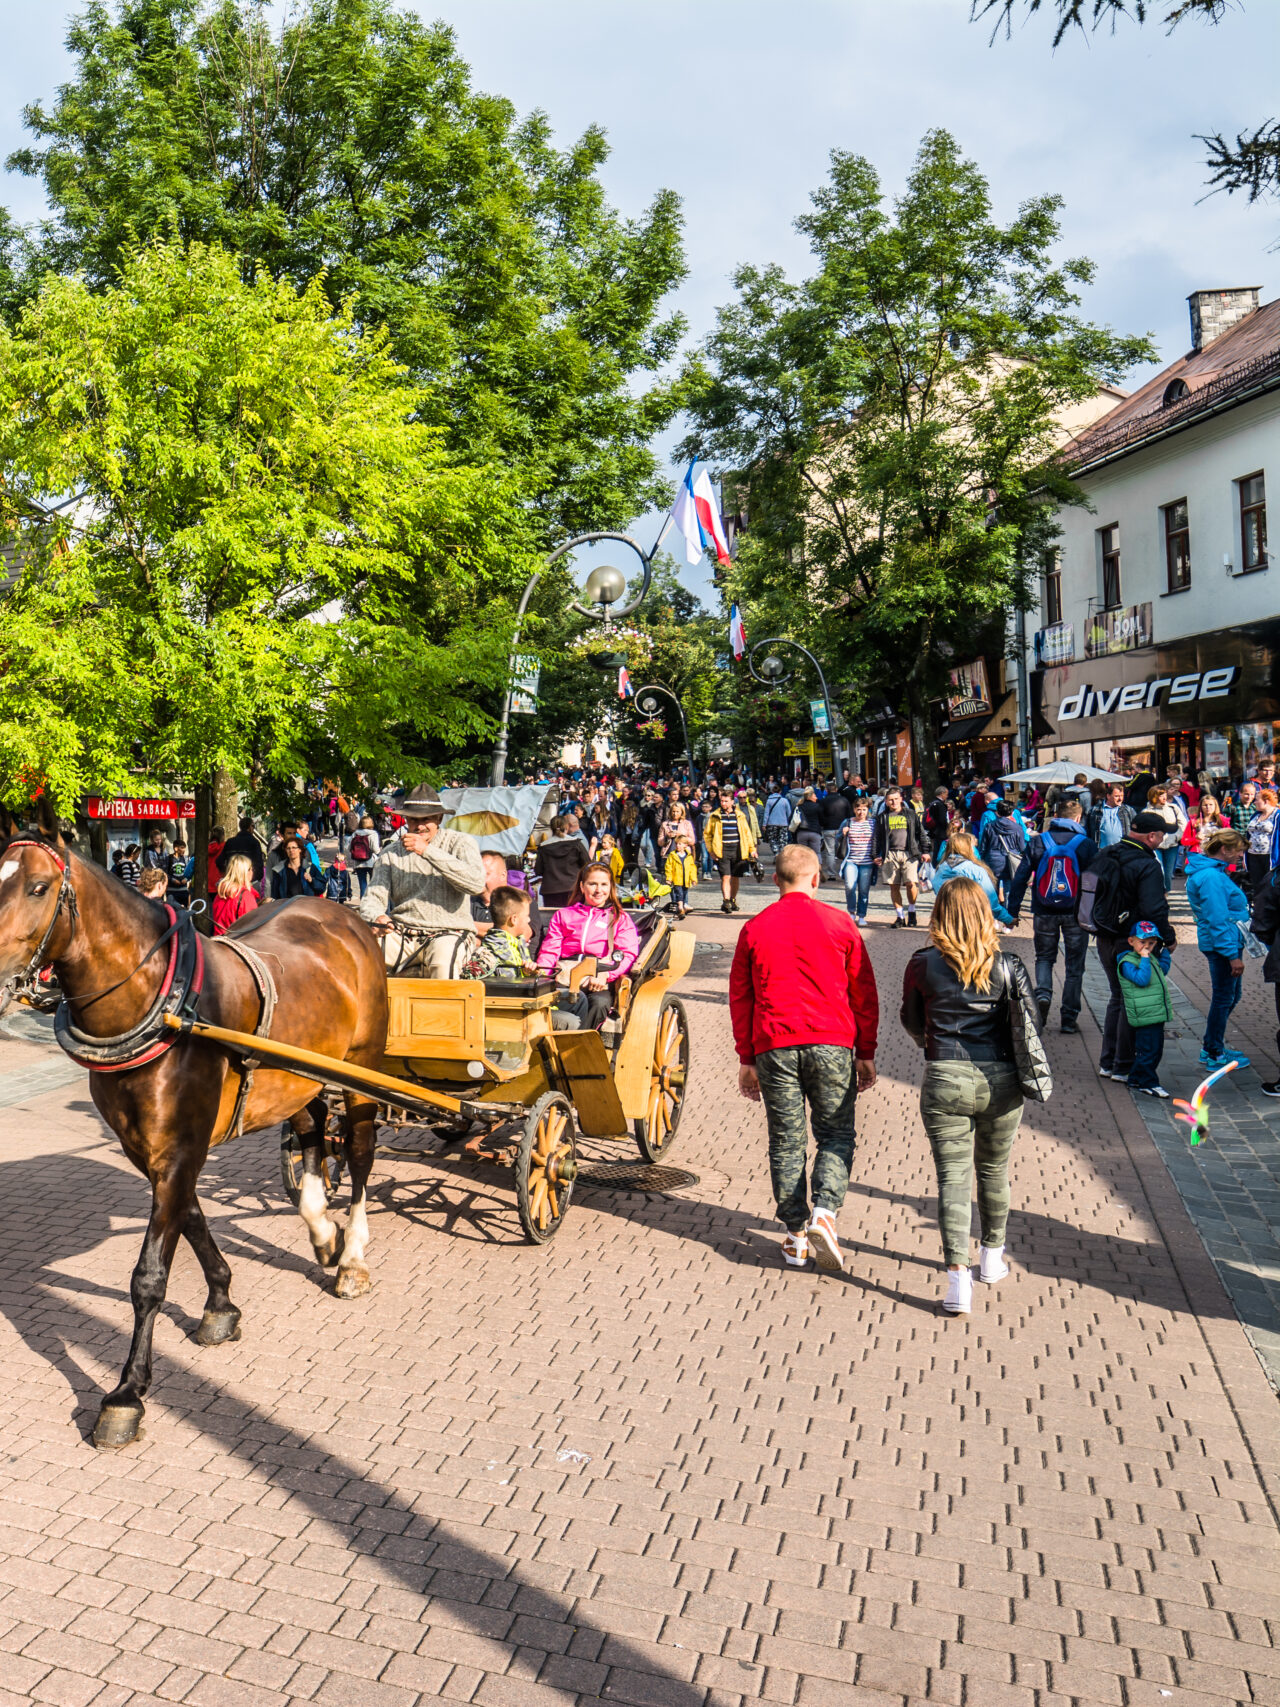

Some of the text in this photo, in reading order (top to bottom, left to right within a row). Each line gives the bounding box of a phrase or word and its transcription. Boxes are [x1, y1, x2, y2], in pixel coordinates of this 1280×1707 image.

[1058, 666, 1235, 721] diverse
[98, 800, 170, 816] APTEKA SABAŁA
